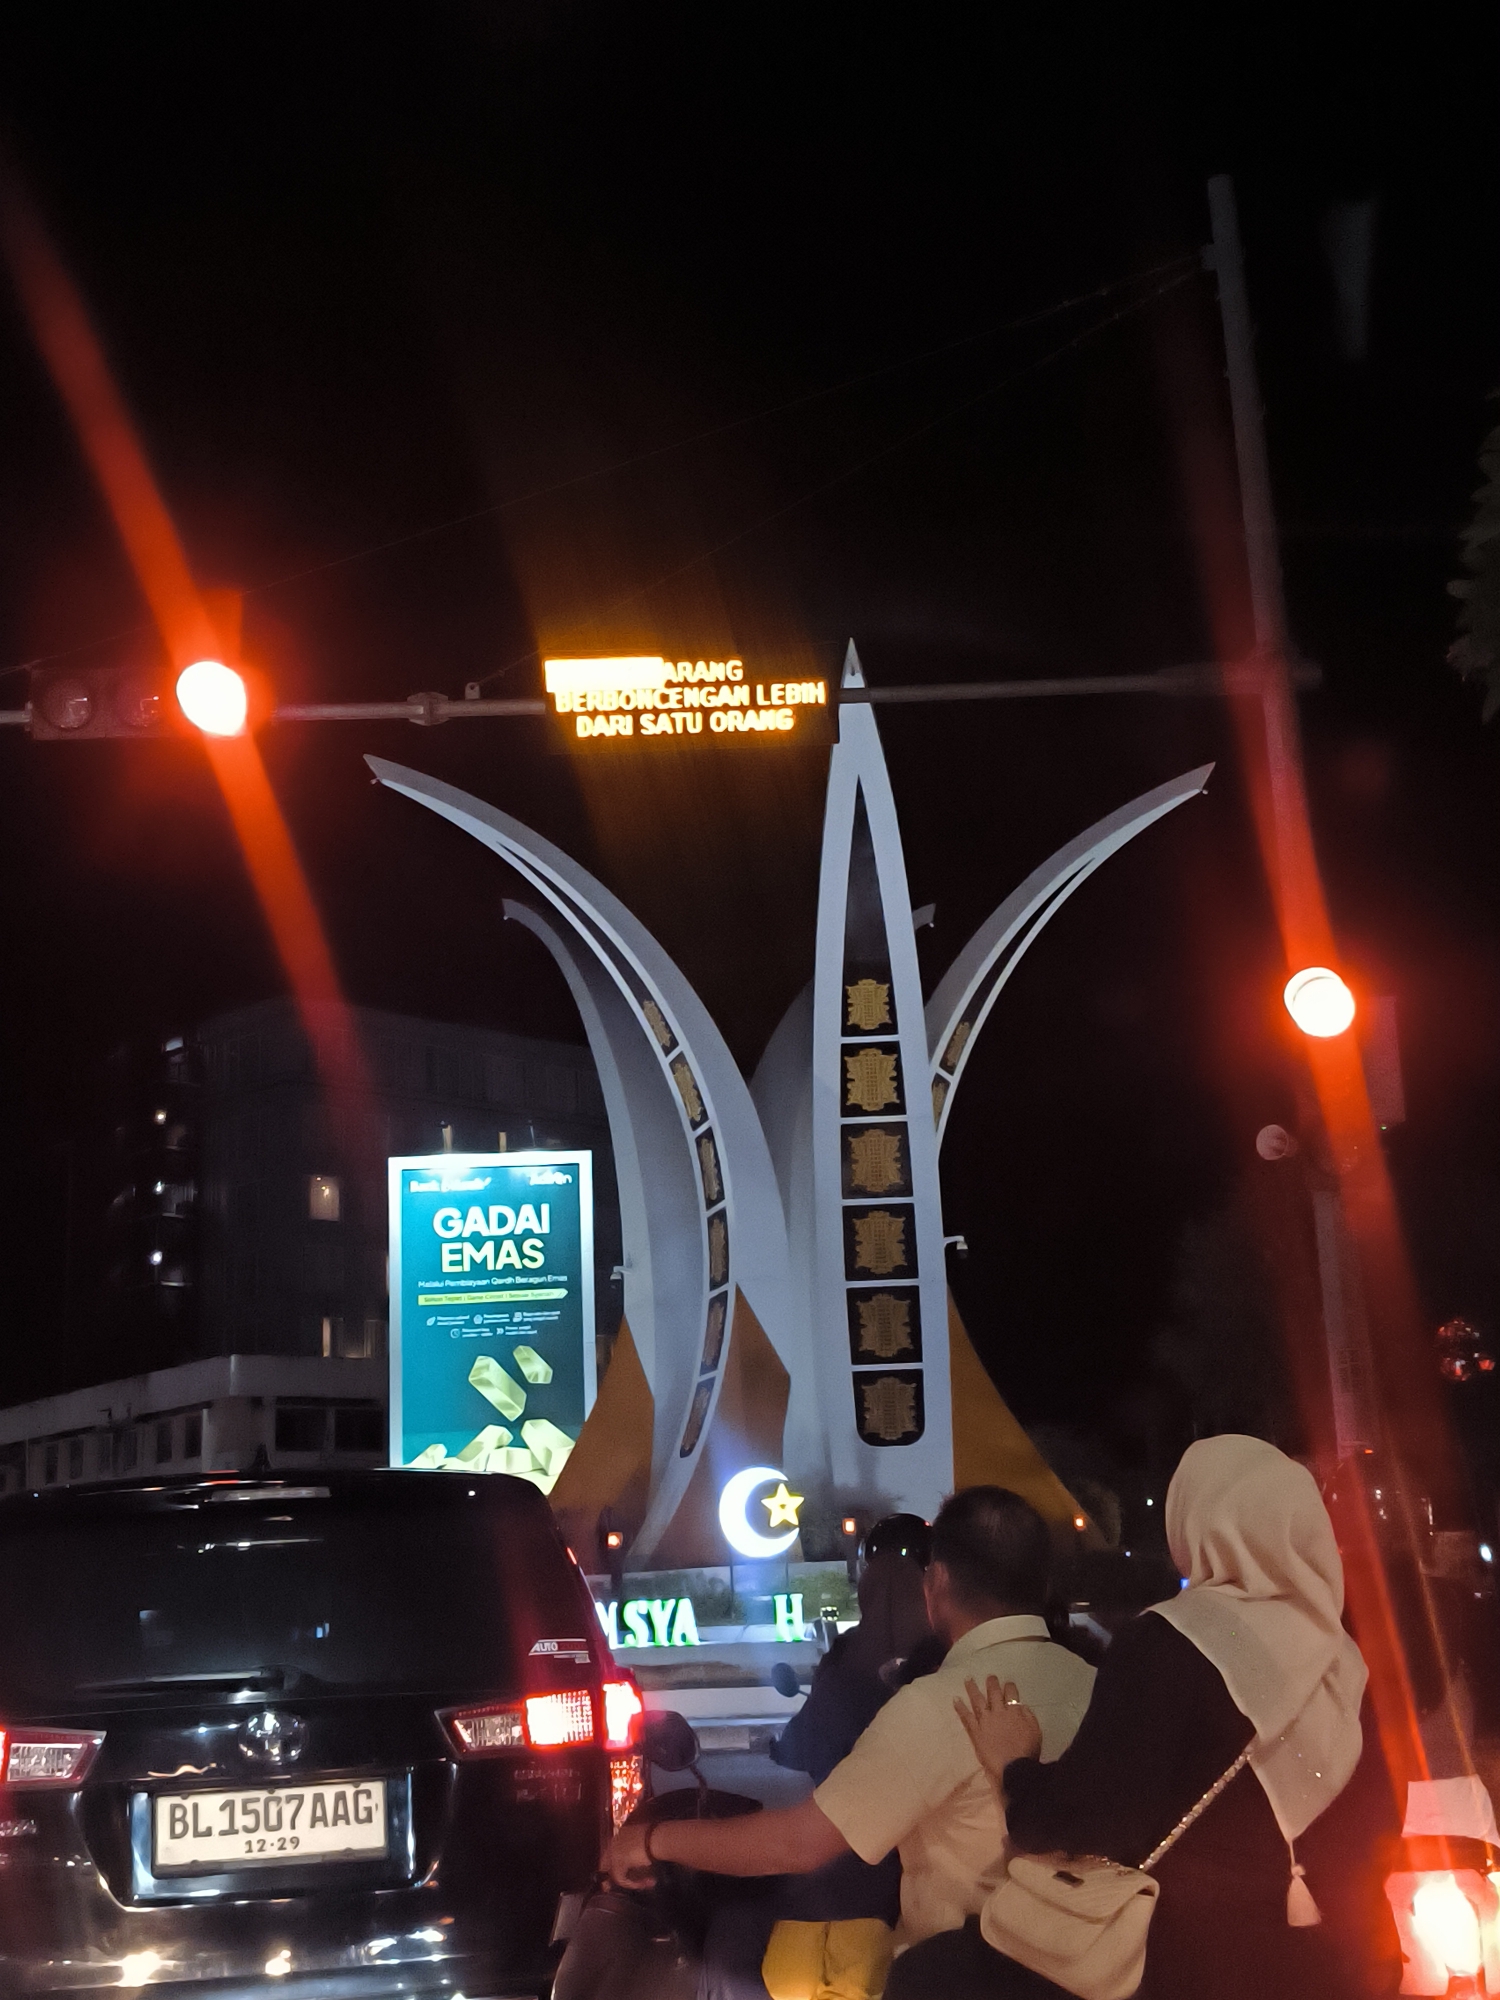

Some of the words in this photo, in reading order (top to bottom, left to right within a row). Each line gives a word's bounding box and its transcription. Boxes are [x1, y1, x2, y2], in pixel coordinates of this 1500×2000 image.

[555, 685, 750, 713] BERBONCENGAN
[756, 682, 826, 705] LEBIH
[576, 715, 633, 738] DARI
[640, 712, 703, 735] SATU
[709, 708, 794, 732] ORANG
[432, 1203, 550, 1239] GADAI
[441, 1238, 545, 1273] EMAS
[530, 1641, 559, 1653] AUTO
[169, 1802, 213, 1840] BL
[218, 1794, 305, 1837] 1507
[309, 1788, 374, 1829] AAG
